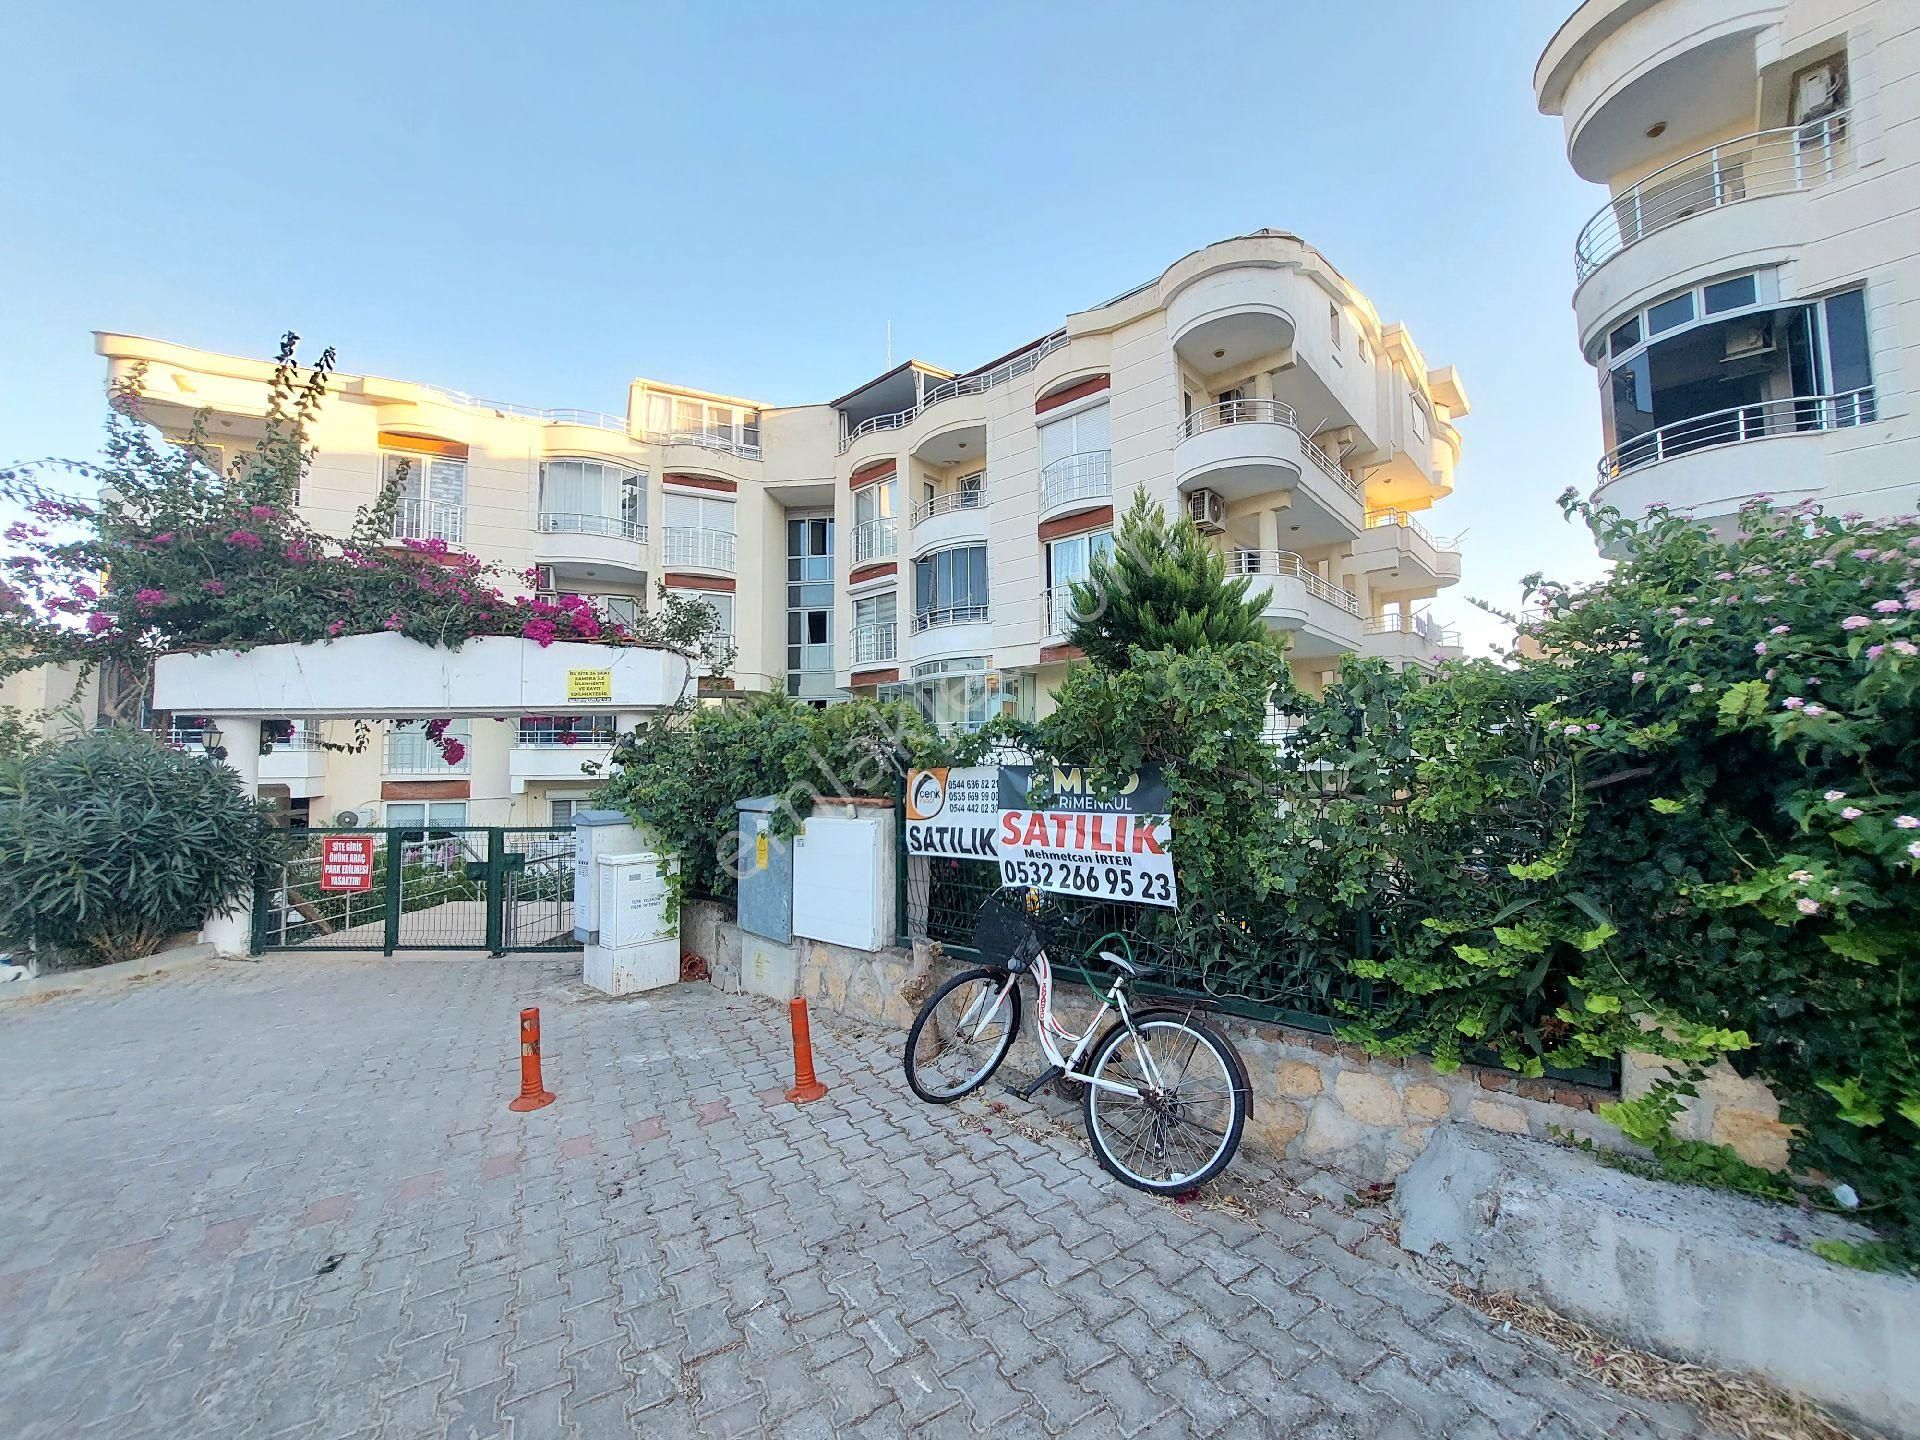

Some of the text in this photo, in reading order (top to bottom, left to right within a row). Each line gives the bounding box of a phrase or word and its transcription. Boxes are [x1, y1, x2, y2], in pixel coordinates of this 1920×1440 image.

[948, 780, 964, 789] 0544
[1001, 811, 1166, 855] SATILIK
[332, 841, 362, 852] SİTE GİRİŞ
[909, 825, 998, 857] SATILIK
[329, 852, 366, 864] ÖNÜNE ARAÇ
[1024, 849, 1133, 866] Mehmetcan İRTEN
[325, 865, 341, 874] PARK
[1004, 860, 1171, 901] 0532 266 95 23
